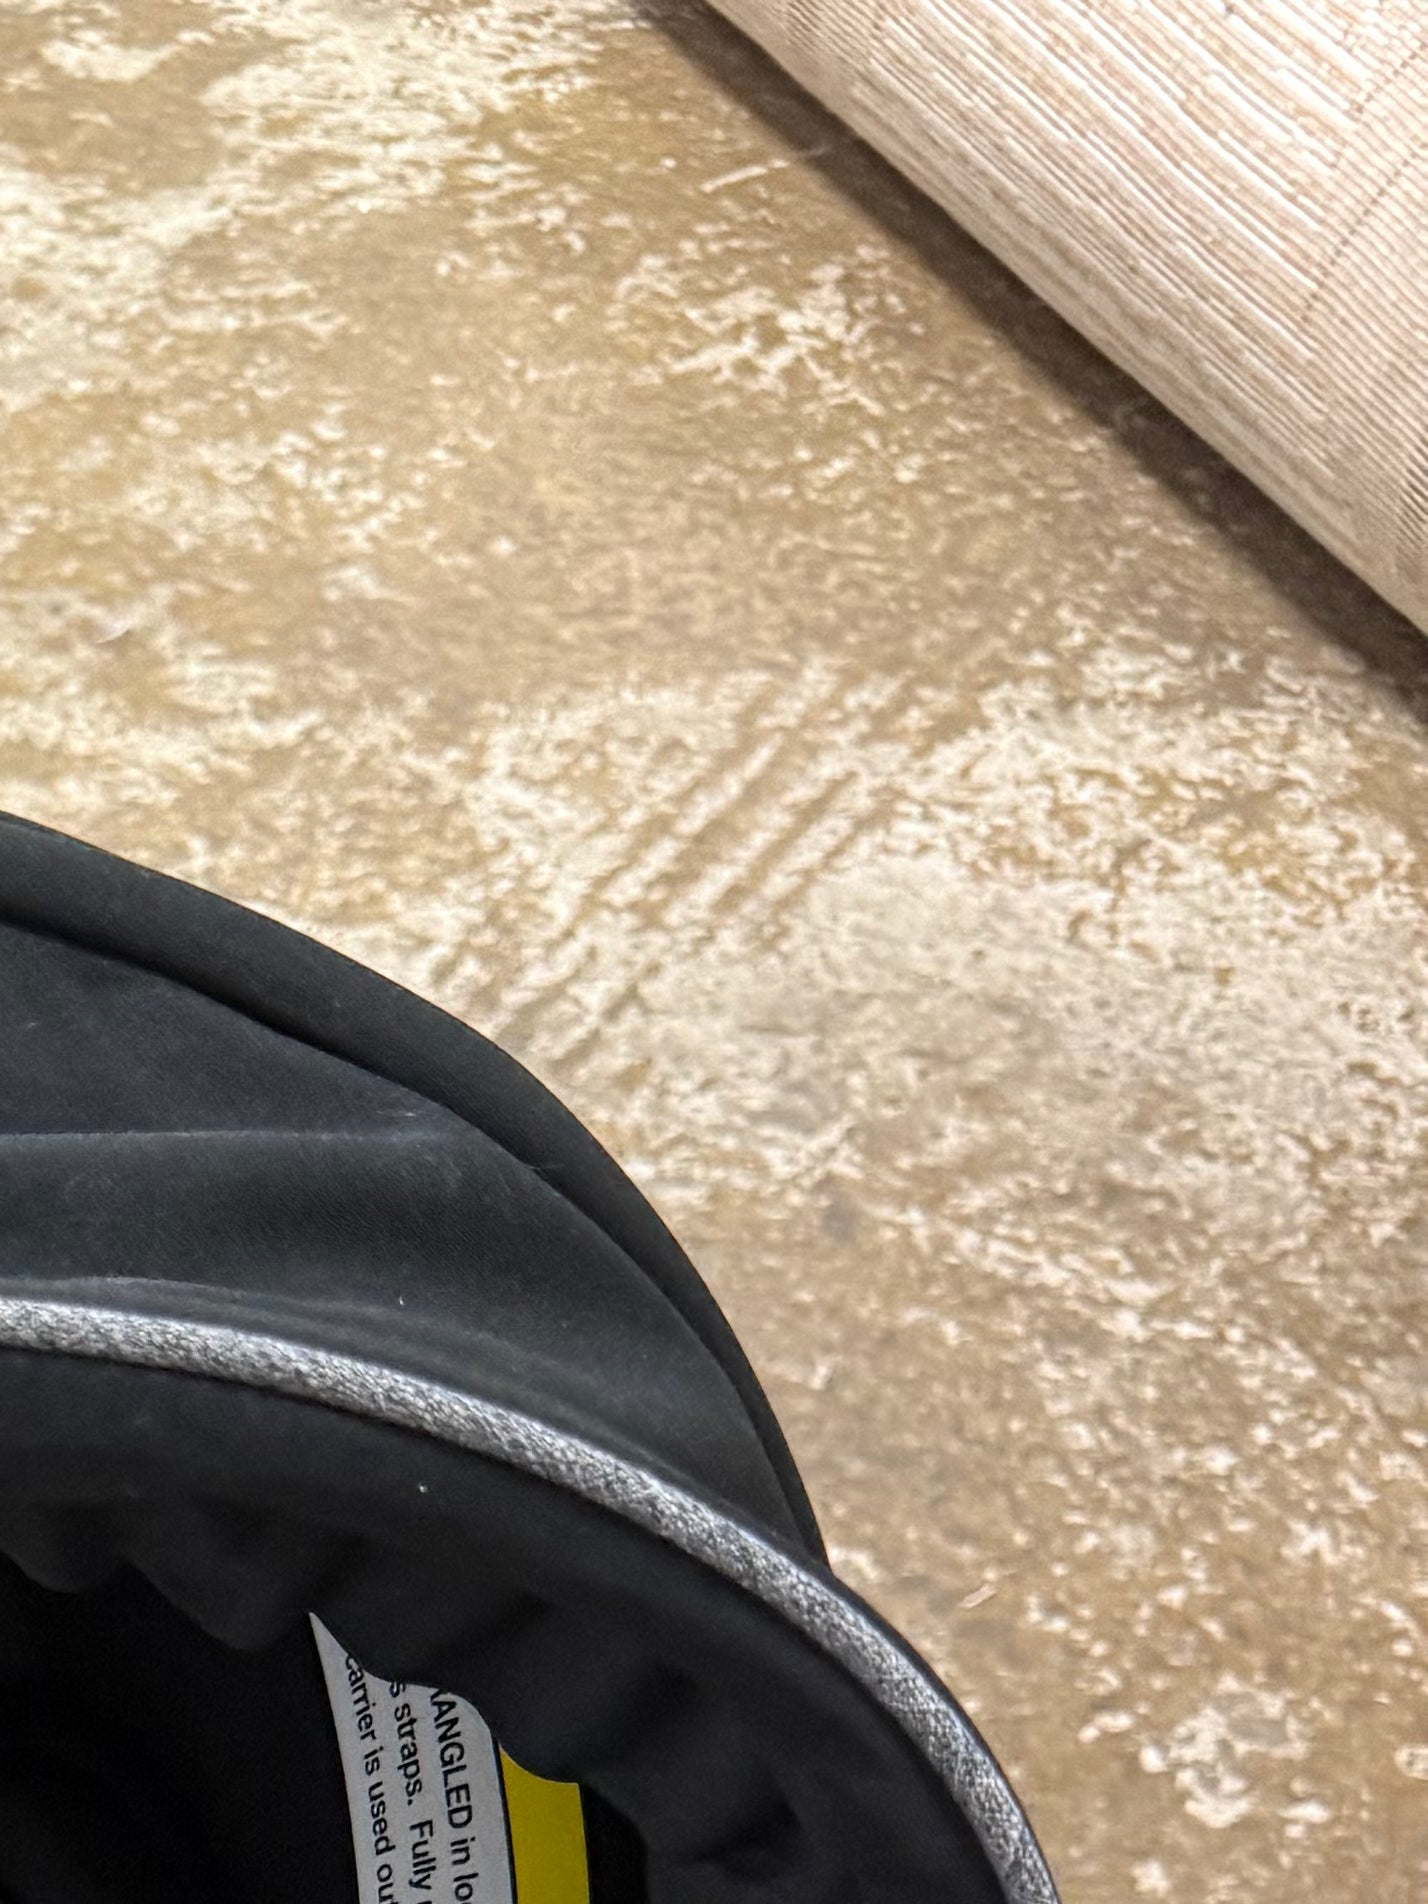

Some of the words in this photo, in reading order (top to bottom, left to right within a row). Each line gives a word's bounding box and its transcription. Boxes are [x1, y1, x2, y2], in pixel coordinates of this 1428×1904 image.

[363, 1746, 384, 1776] is
[368, 1781, 396, 1856] used
[394, 1703, 422, 1806] straps.
[408, 1819, 437, 1890] Fully
[450, 1837, 476, 1865] in
